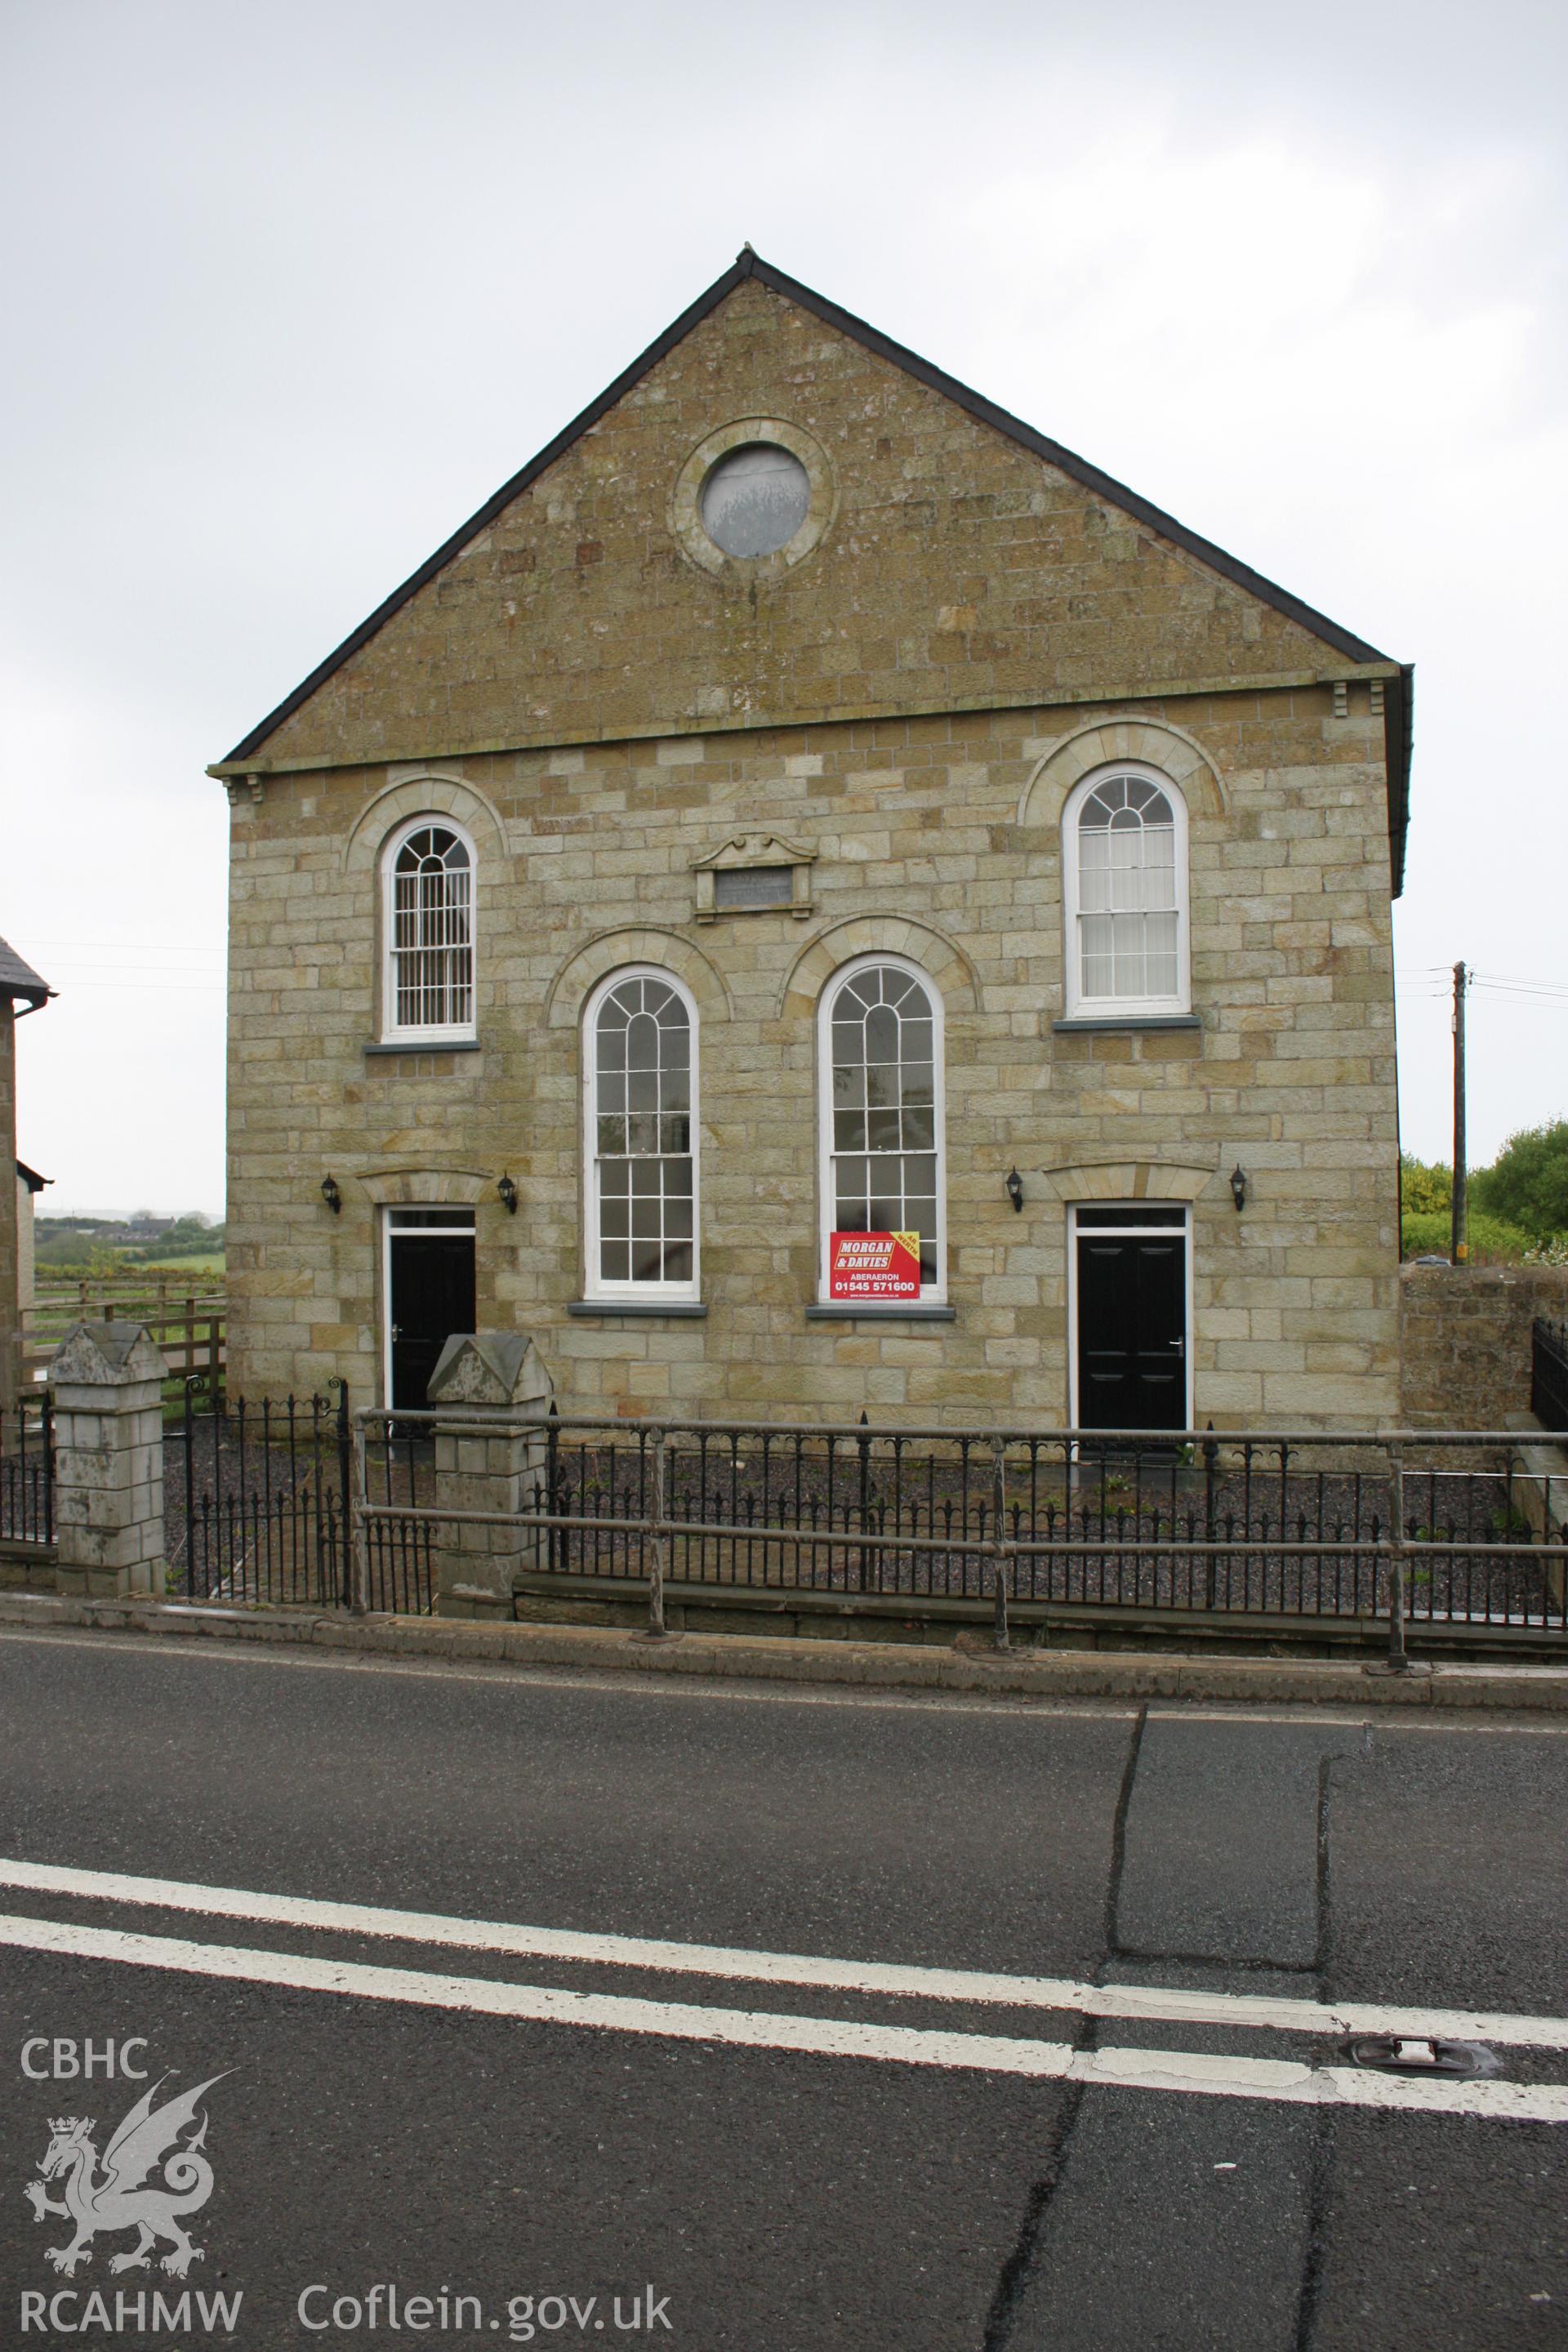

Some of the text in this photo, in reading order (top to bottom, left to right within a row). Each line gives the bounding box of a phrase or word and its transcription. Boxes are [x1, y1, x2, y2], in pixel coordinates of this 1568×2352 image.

[840, 1242, 893, 1253] MORGAN
[898, 1234, 918, 1255] WERTH
[837, 1257, 889, 1267] & DAVIES
[835, 1282, 915, 1290] 01545 571600
